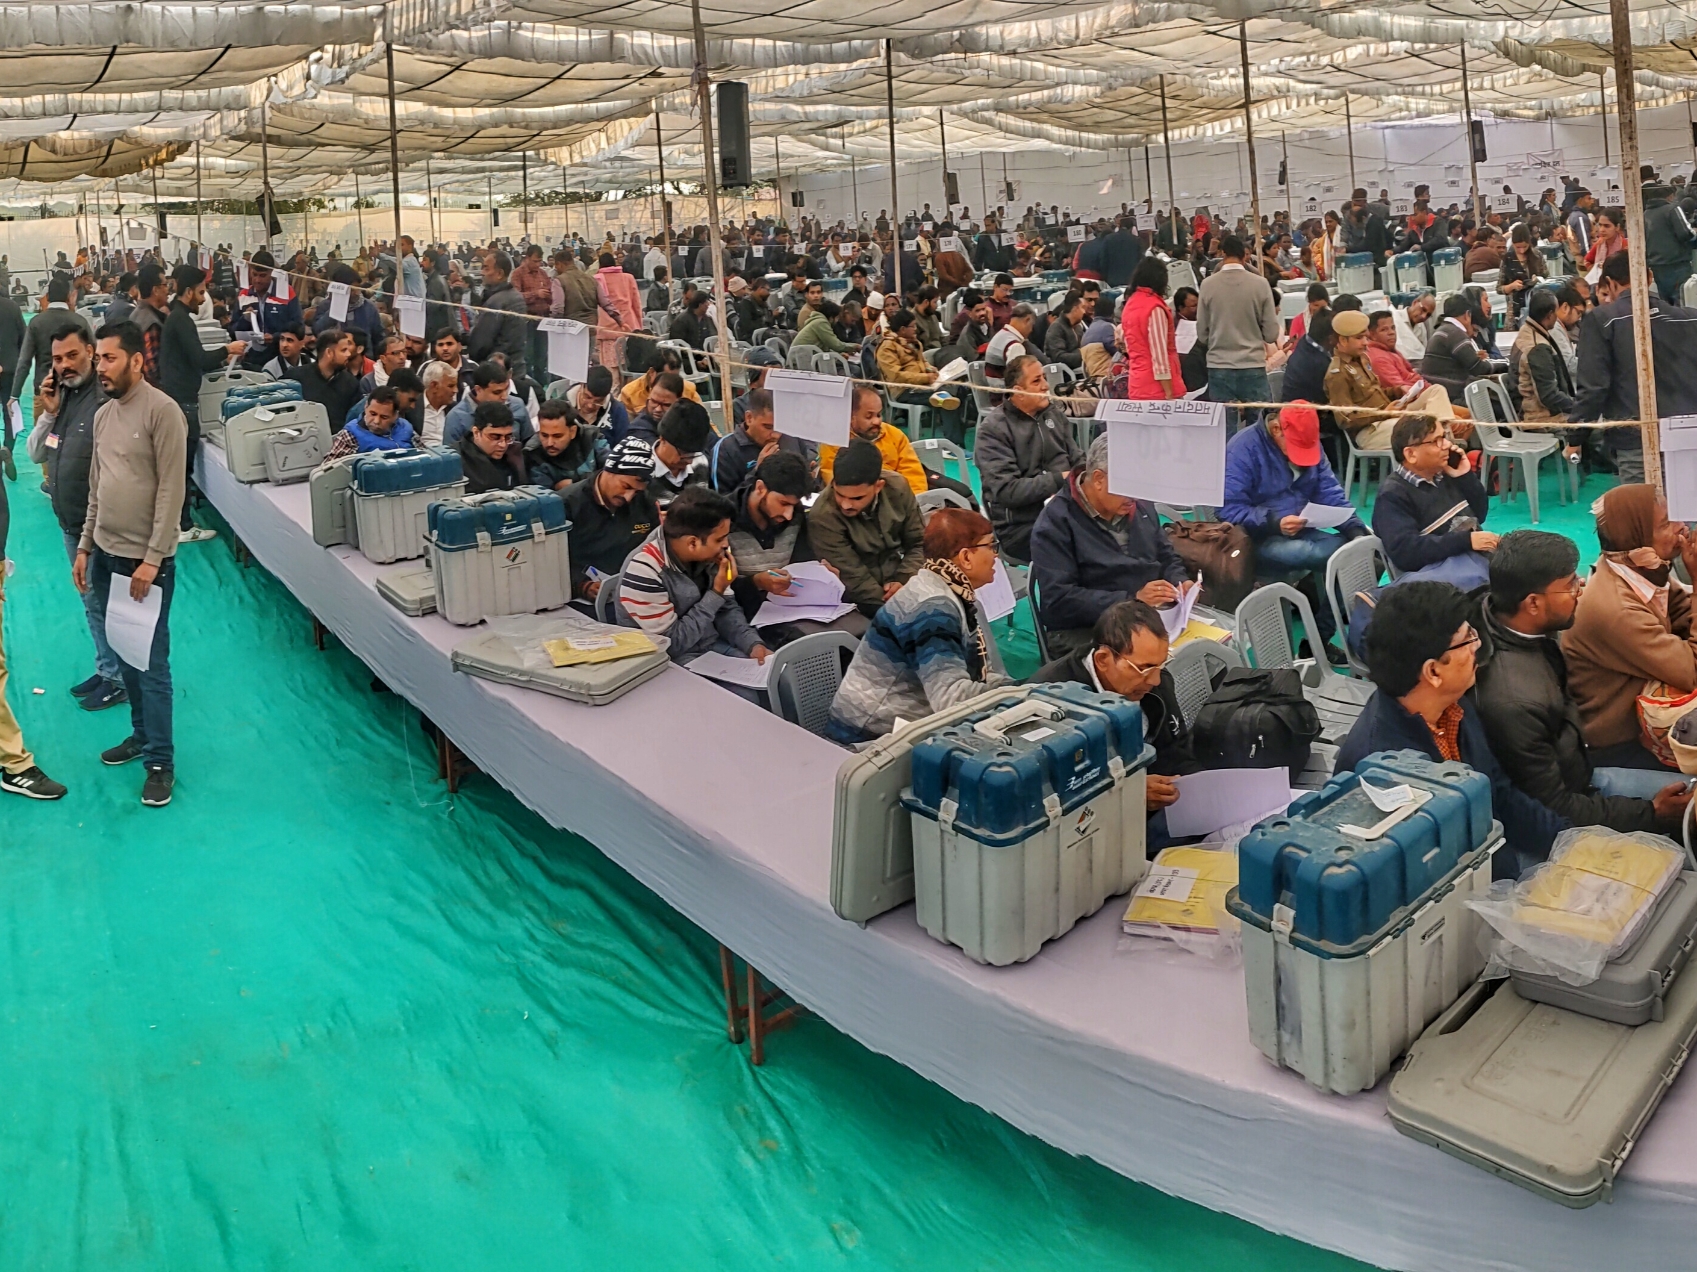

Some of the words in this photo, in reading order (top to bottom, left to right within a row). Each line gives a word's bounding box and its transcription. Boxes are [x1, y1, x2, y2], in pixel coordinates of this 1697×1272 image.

[1497, 198, 1510, 206] 184
[1606, 195, 1620, 203] 185
[1395, 205, 1408, 213] 183
[619, 454, 655, 468] NIKE
